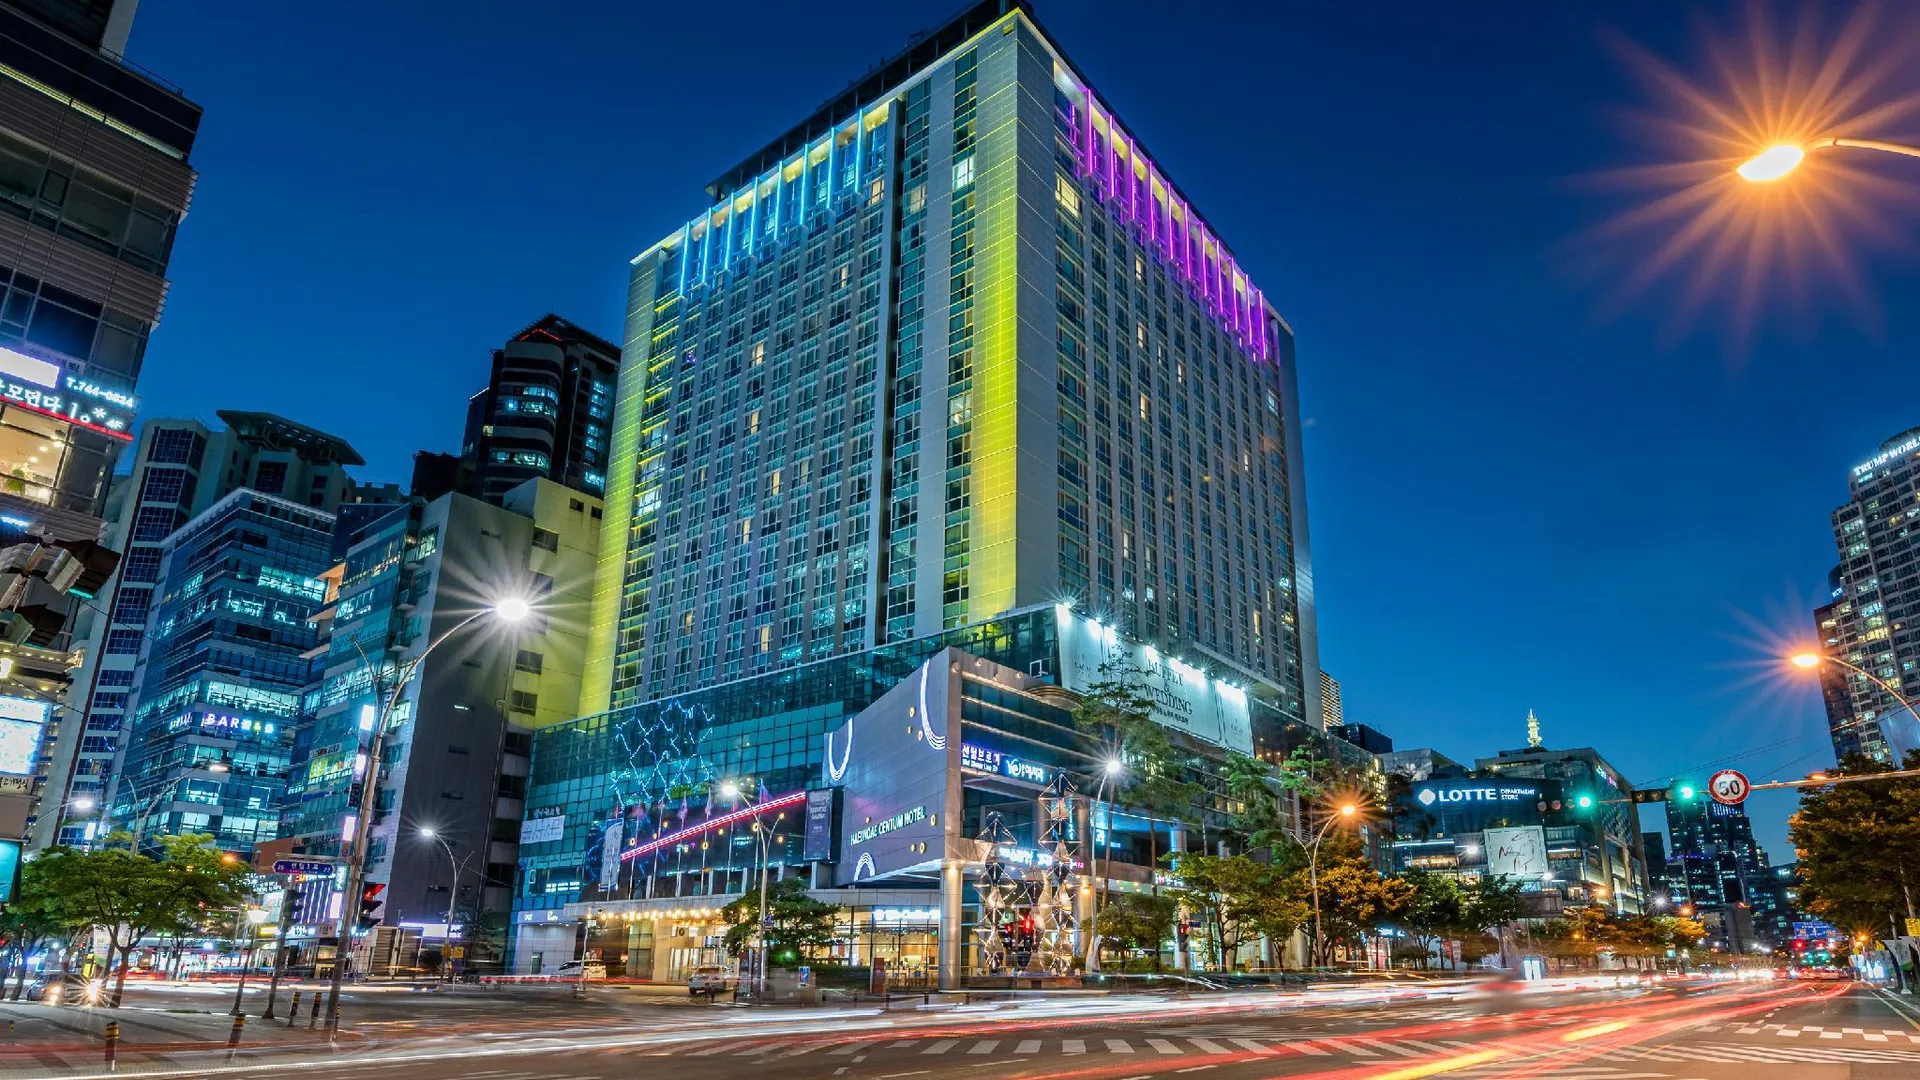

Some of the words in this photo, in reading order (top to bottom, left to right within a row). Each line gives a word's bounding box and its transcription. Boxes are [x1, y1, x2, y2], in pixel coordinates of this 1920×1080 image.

[1853, 453, 1889, 475] TRUMP
[1142, 683, 1193, 715] WEDDING
[1438, 788, 1497, 802] LOTTE
[1720, 780, 1740, 796] 50
[850, 824, 877, 846] HAEUNDAE
[879, 814, 903, 834] CENTUM
[904, 806, 925, 826] HOTEL
